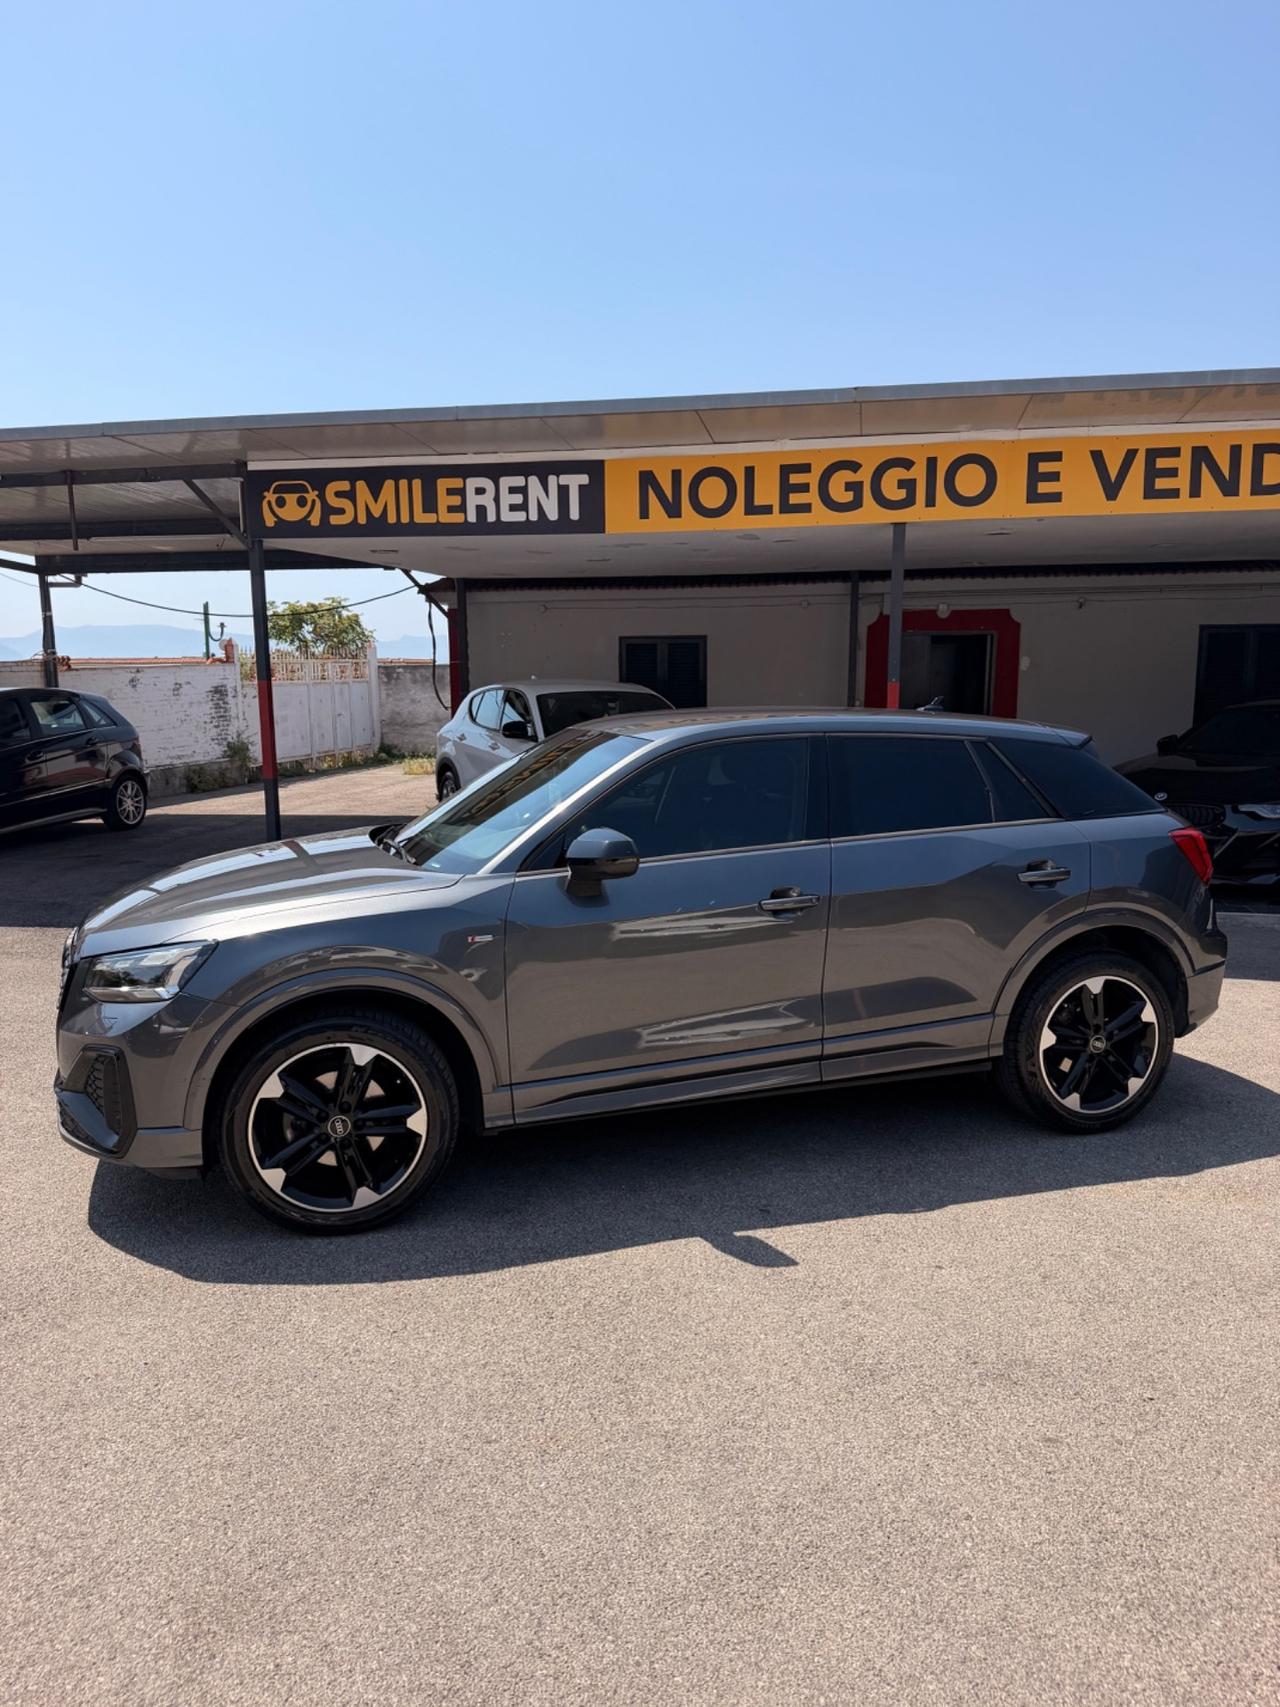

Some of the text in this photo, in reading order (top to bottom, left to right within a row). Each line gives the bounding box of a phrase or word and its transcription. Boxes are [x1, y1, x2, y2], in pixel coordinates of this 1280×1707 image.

[325, 474, 590, 526] SMILERENT
[638, 453, 998, 520] NOLEGGIO
[1026, 450, 1063, 504] E
